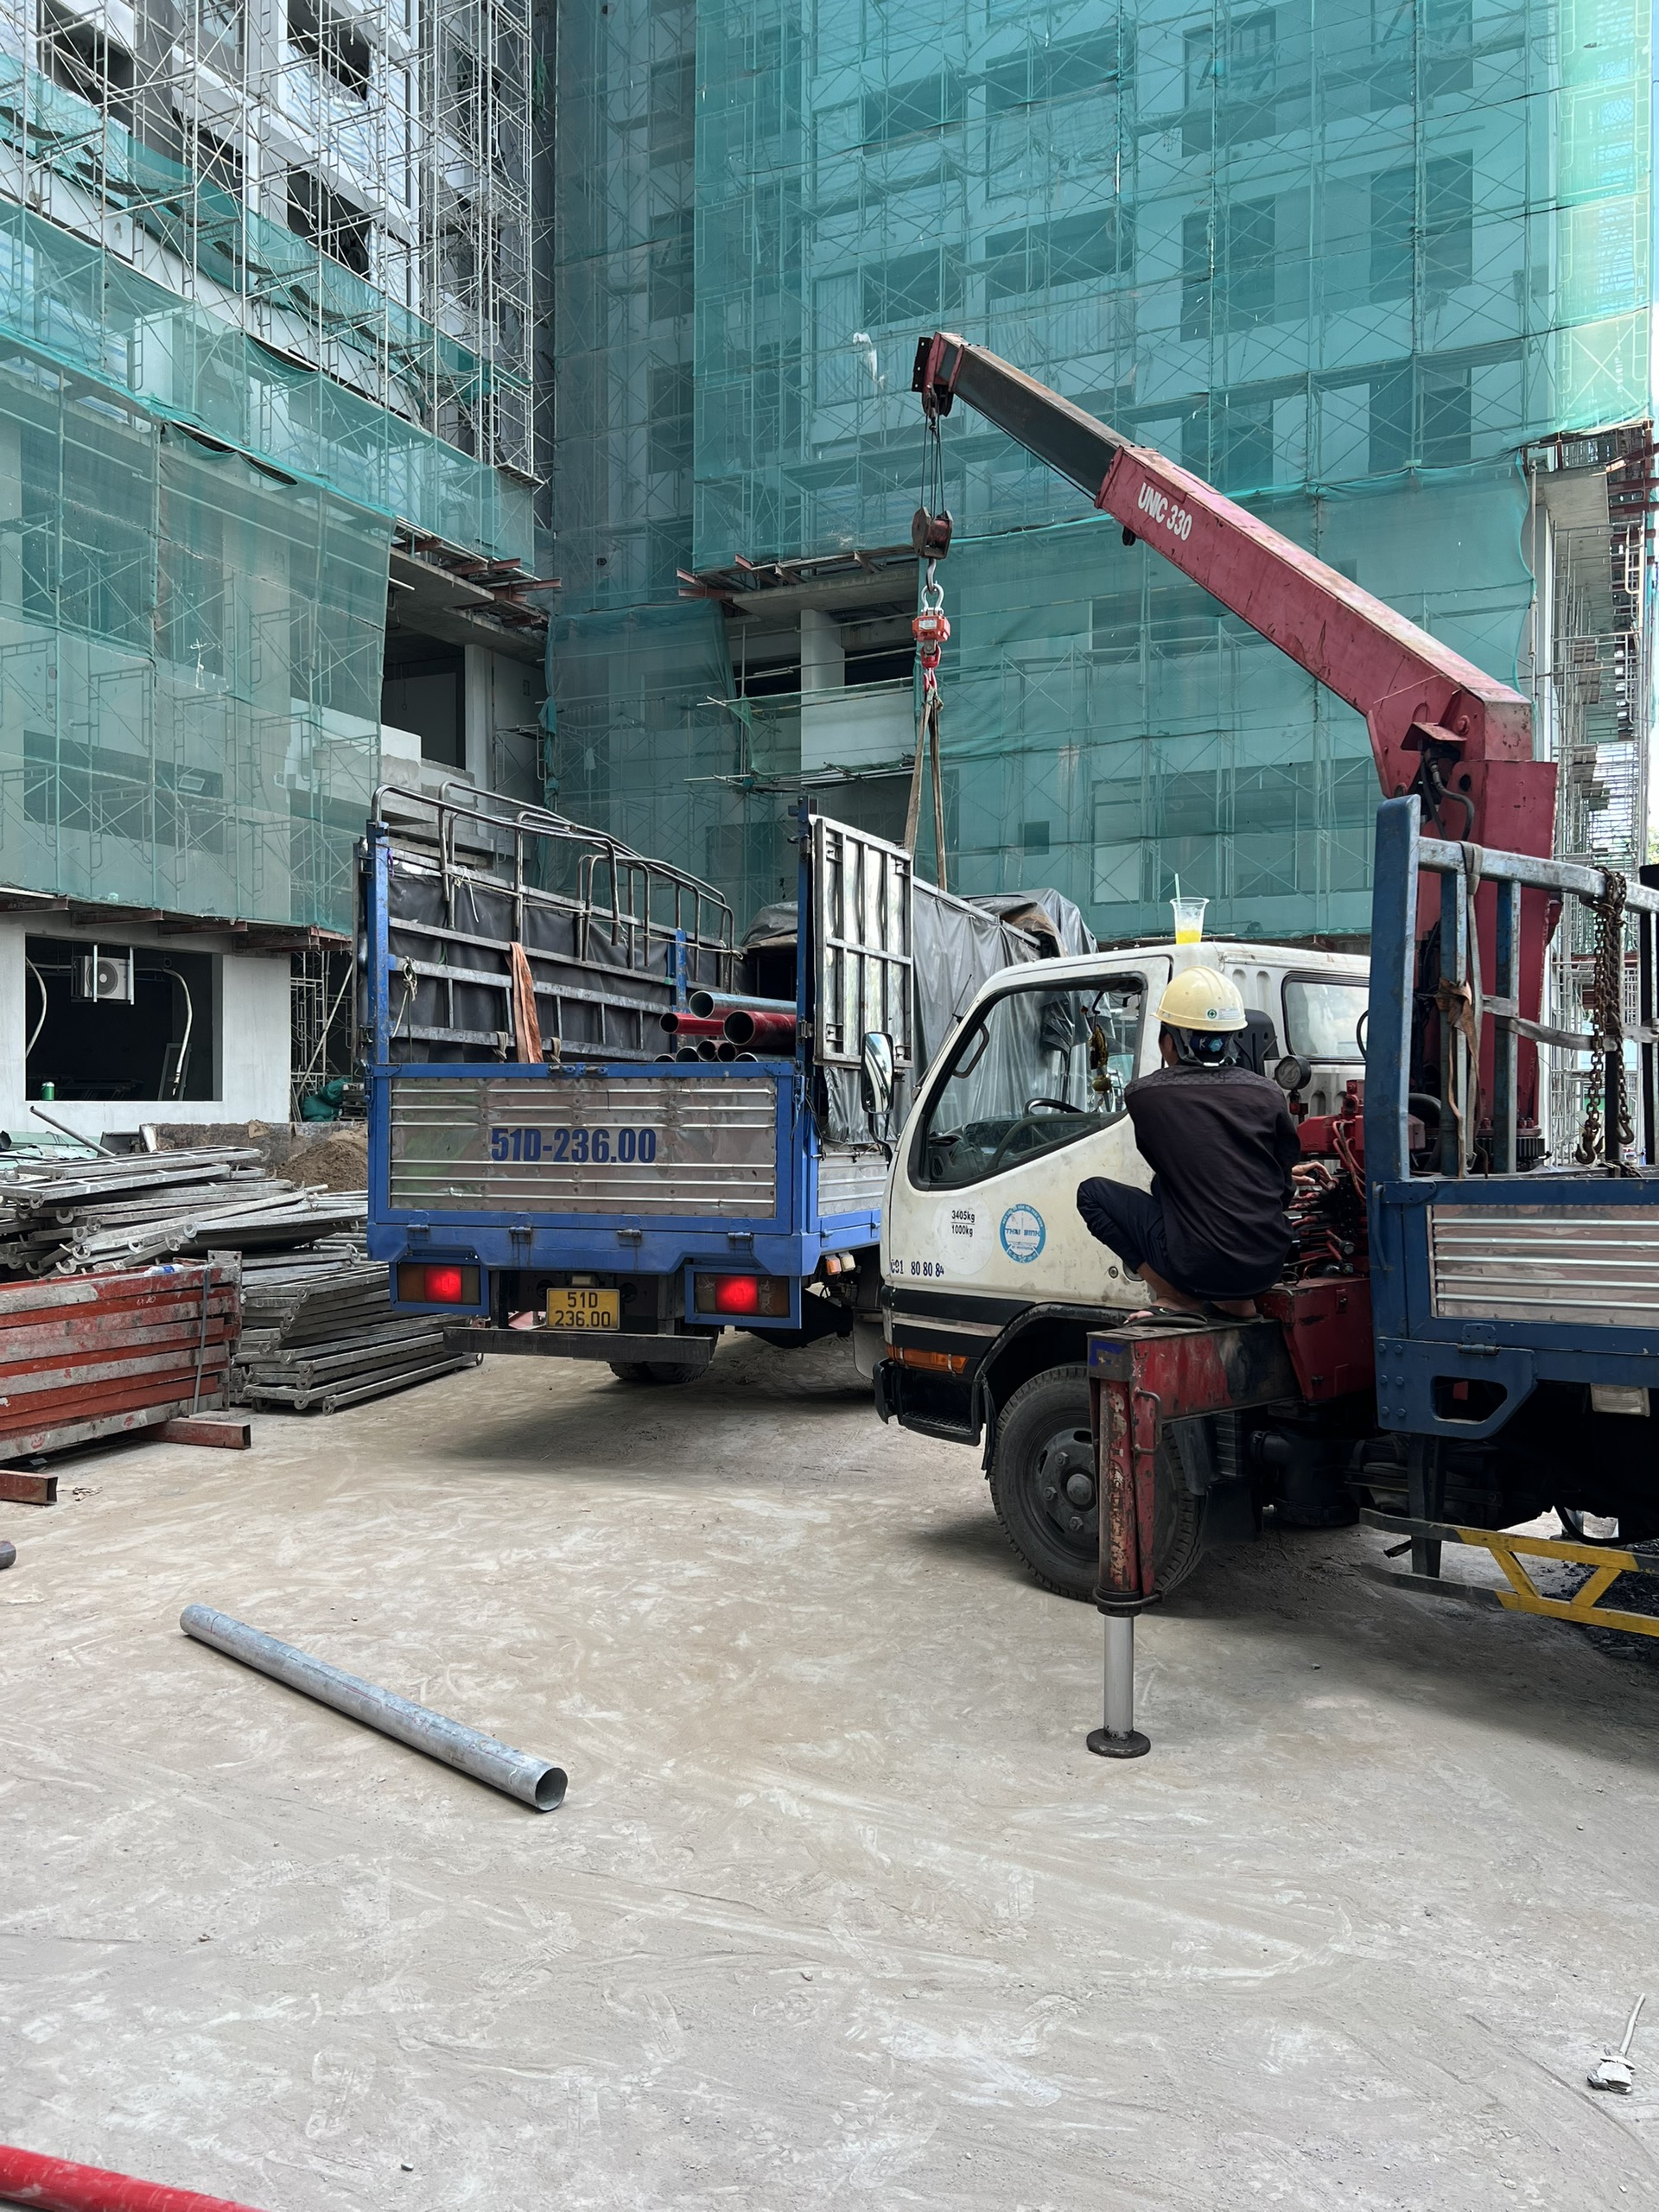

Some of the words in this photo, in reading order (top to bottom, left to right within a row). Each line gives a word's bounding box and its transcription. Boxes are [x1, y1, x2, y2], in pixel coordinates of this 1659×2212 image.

[1138, 482, 1168, 524] UNIC
[1166, 505, 1192, 541] 330
[491, 1128, 657, 1163] 51D-236.00
[951, 1210, 976, 1223] 3405kg
[951, 1224, 974, 1237] 1000kg
[911, 1261, 921, 1275] 80
[923, 1262, 933, 1276] 80
[568, 1292, 598, 1308] 51D
[555, 1310, 610, 1327] 236.00
